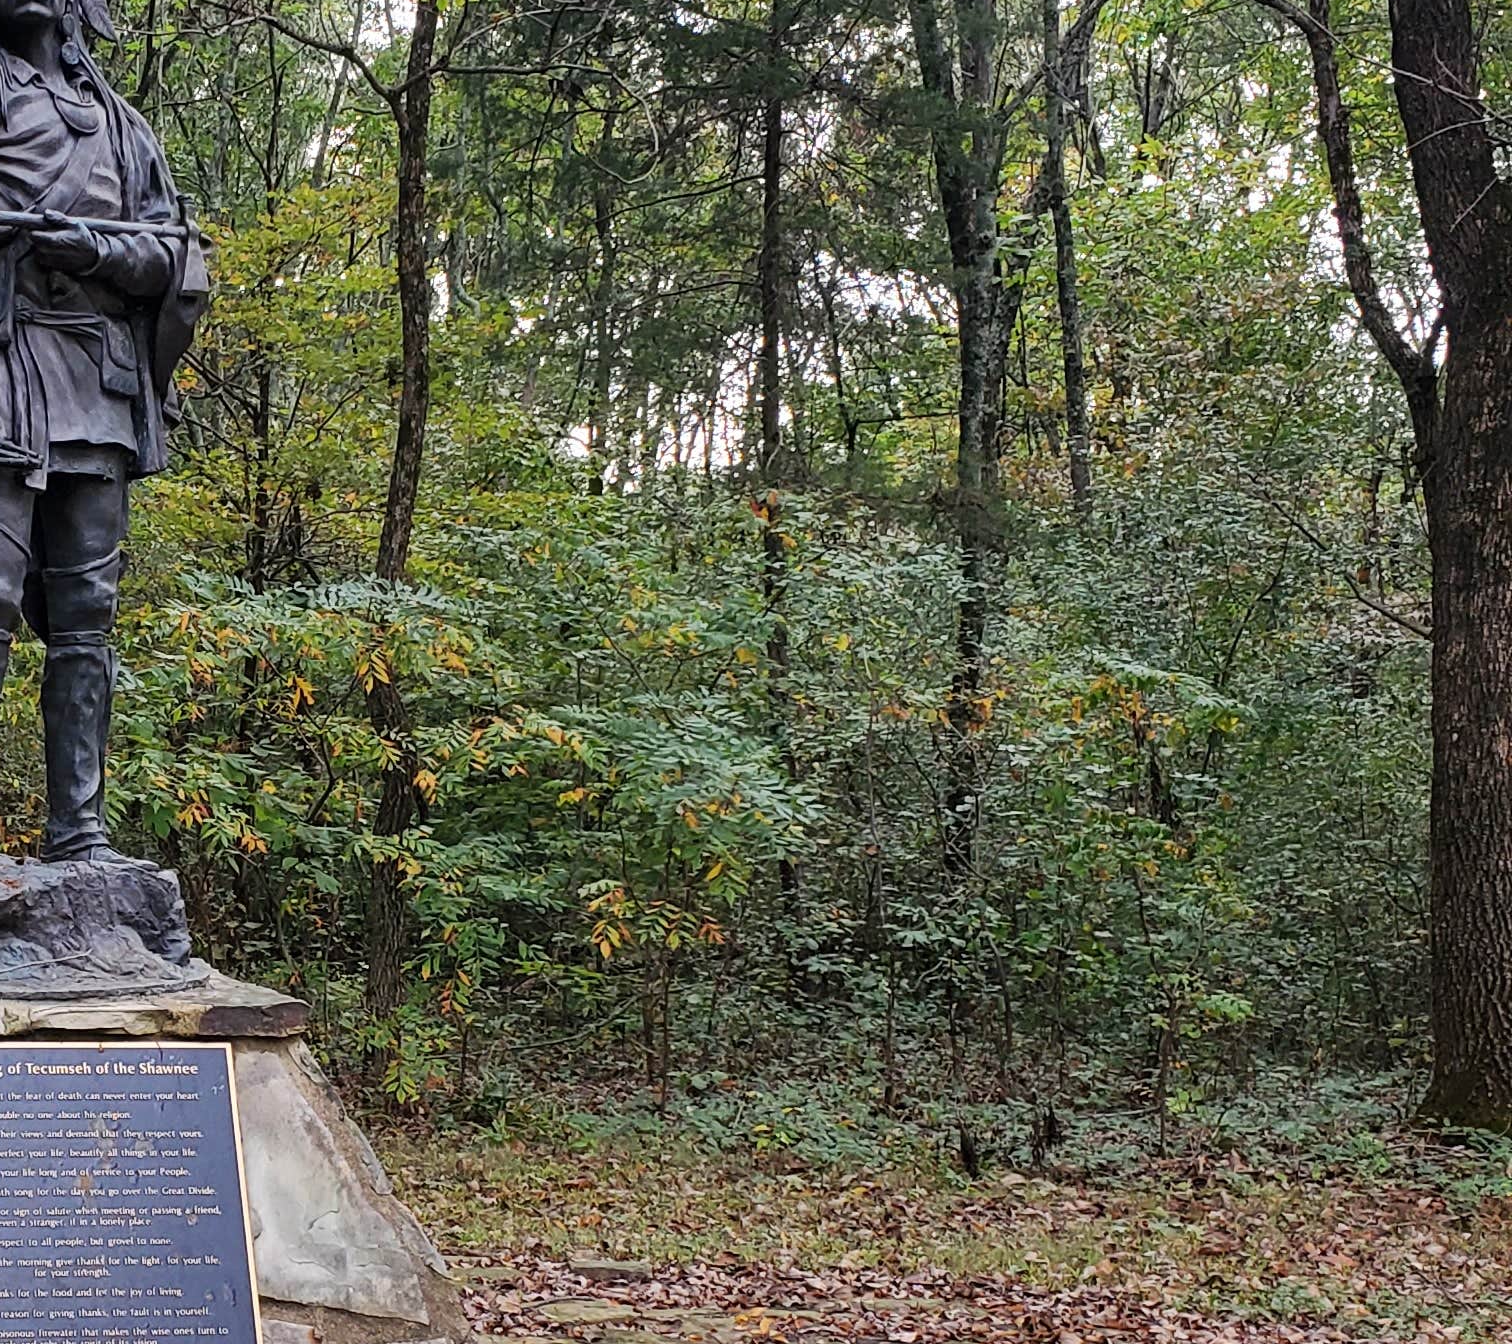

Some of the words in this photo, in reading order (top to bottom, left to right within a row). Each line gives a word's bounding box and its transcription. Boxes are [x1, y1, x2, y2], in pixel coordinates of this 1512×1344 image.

[6, 1061, 22, 1074] of
[24, 1061, 92, 1074] Tecumseh
[94, 1061, 111, 1074] of
[112, 1061, 136, 1074] the
[138, 1061, 199, 1074] Shawnee
[7, 1091, 22, 1100] the
[24, 1091, 42, 1100] fear
[44, 1091, 55, 1100] of
[57, 1091, 82, 1100] death
[128, 1091, 152, 1099] enter
[154, 1093, 174, 1101] your
[56, 1110, 81, 1118] about
[83, 1110, 97, 1118] his
[20, 1129, 44, 1138] views
[46, 1129, 63, 1138] and
[65, 1129, 99, 1137] demand
[101, 1129, 119, 1137] that
[122, 1128, 142, 1139] they
[144, 1128, 176, 1139] respect
[0, 1170, 19, 1178] your
[21, 1167, 36, 1176] life
[59, 1167, 77, 1176] and
[78, 1167, 89, 1176] of
[91, 1167, 122, 1176] service
[124, 1167, 137, 1175] to
[137, 1169, 157, 1177] your
[13, 1189, 34, 1197] song
[36, 1187, 49, 1196] for
[52, 1186, 68, 1195] the
[69, 1186, 86, 1197] day
[88, 1188, 106, 1197] you
[107, 1188, 120, 1197] go
[143, 1186, 159, 1195] the
[161, 1186, 185, 1195] Great
[27, 1237, 38, 1246] to
[40, 1237, 52, 1246] all
[89, 1236, 104, 1245] but
[107, 1236, 134, 1246] grovel
[136, 1236, 147, 1245] to
[33, 1267, 47, 1277] for
[50, 1269, 70, 1278] your
[80, 1327, 99, 1336] that
[101, 1327, 130, 1336] makes
[132, 1327, 148, 1336] the
[150, 1326, 171, 1335] wise
[196, 1326, 216, 1335] turn
[217, 1325, 229, 1334] to
